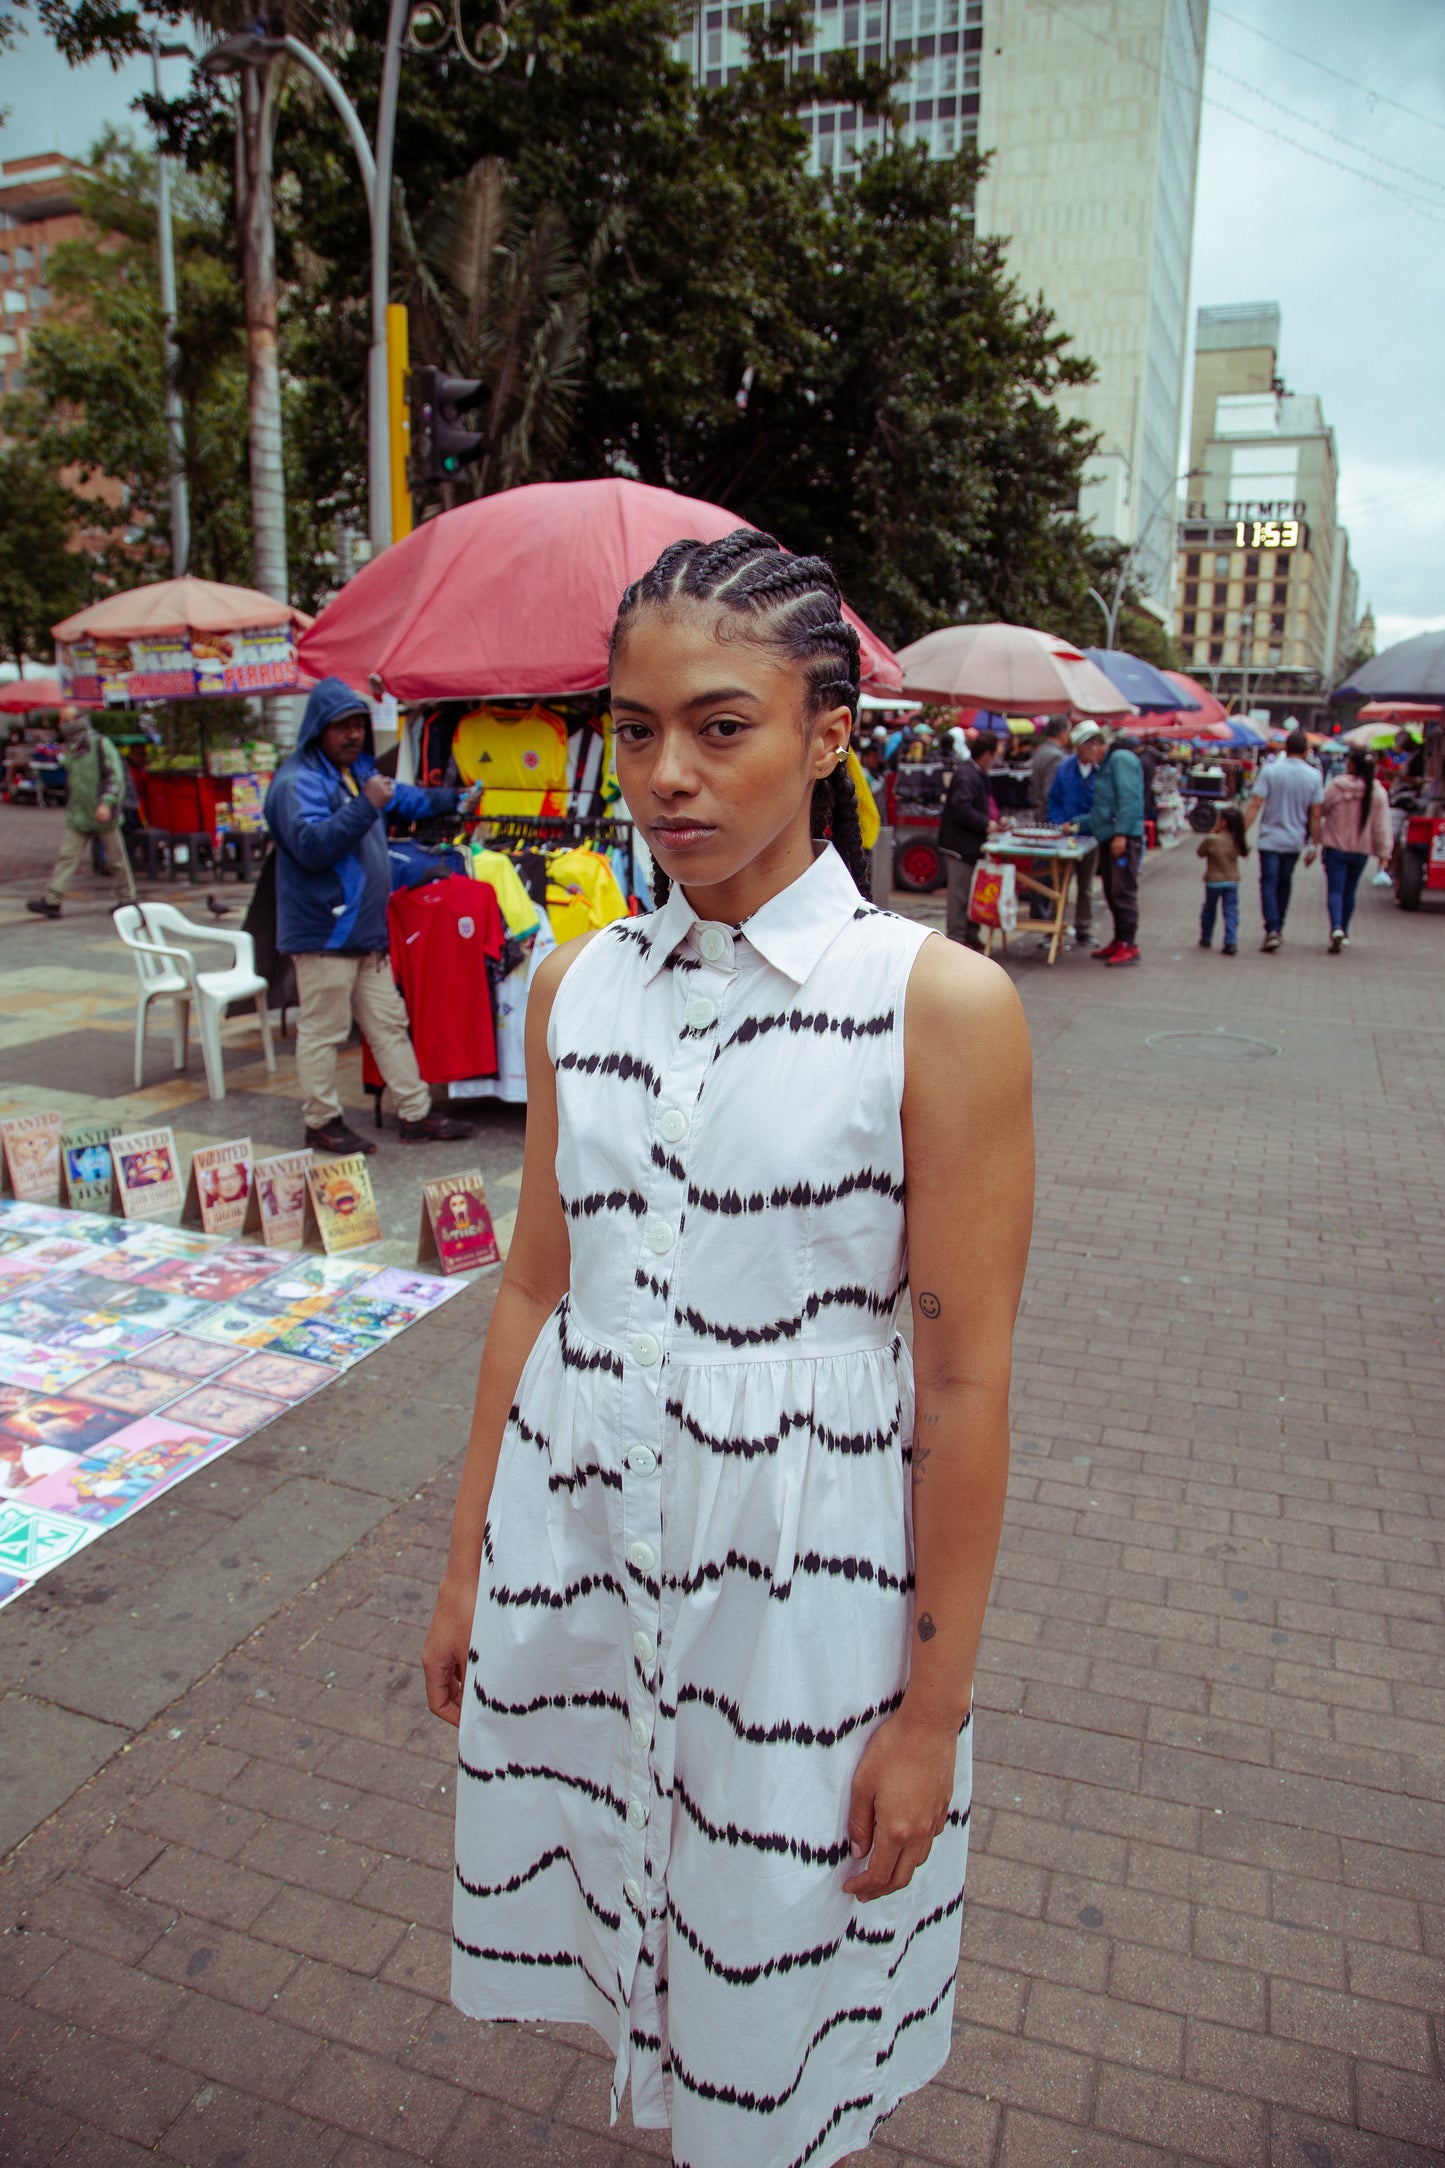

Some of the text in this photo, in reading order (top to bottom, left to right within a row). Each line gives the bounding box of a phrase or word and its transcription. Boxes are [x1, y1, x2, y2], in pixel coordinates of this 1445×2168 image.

[1187, 501, 1306, 519] EL TIEMPO
[1236, 521, 1298, 547] 11:53
[224, 662, 298, 689] PERROS
[4, 1112, 60, 1132] WANTED
[61, 1127, 122, 1146] WANTED
[112, 1130, 169, 1153] WANTED
[197, 1142, 249, 1168] WANTED
[309, 1158, 367, 1181] WANTED
[426, 1173, 483, 1199] WANTED
